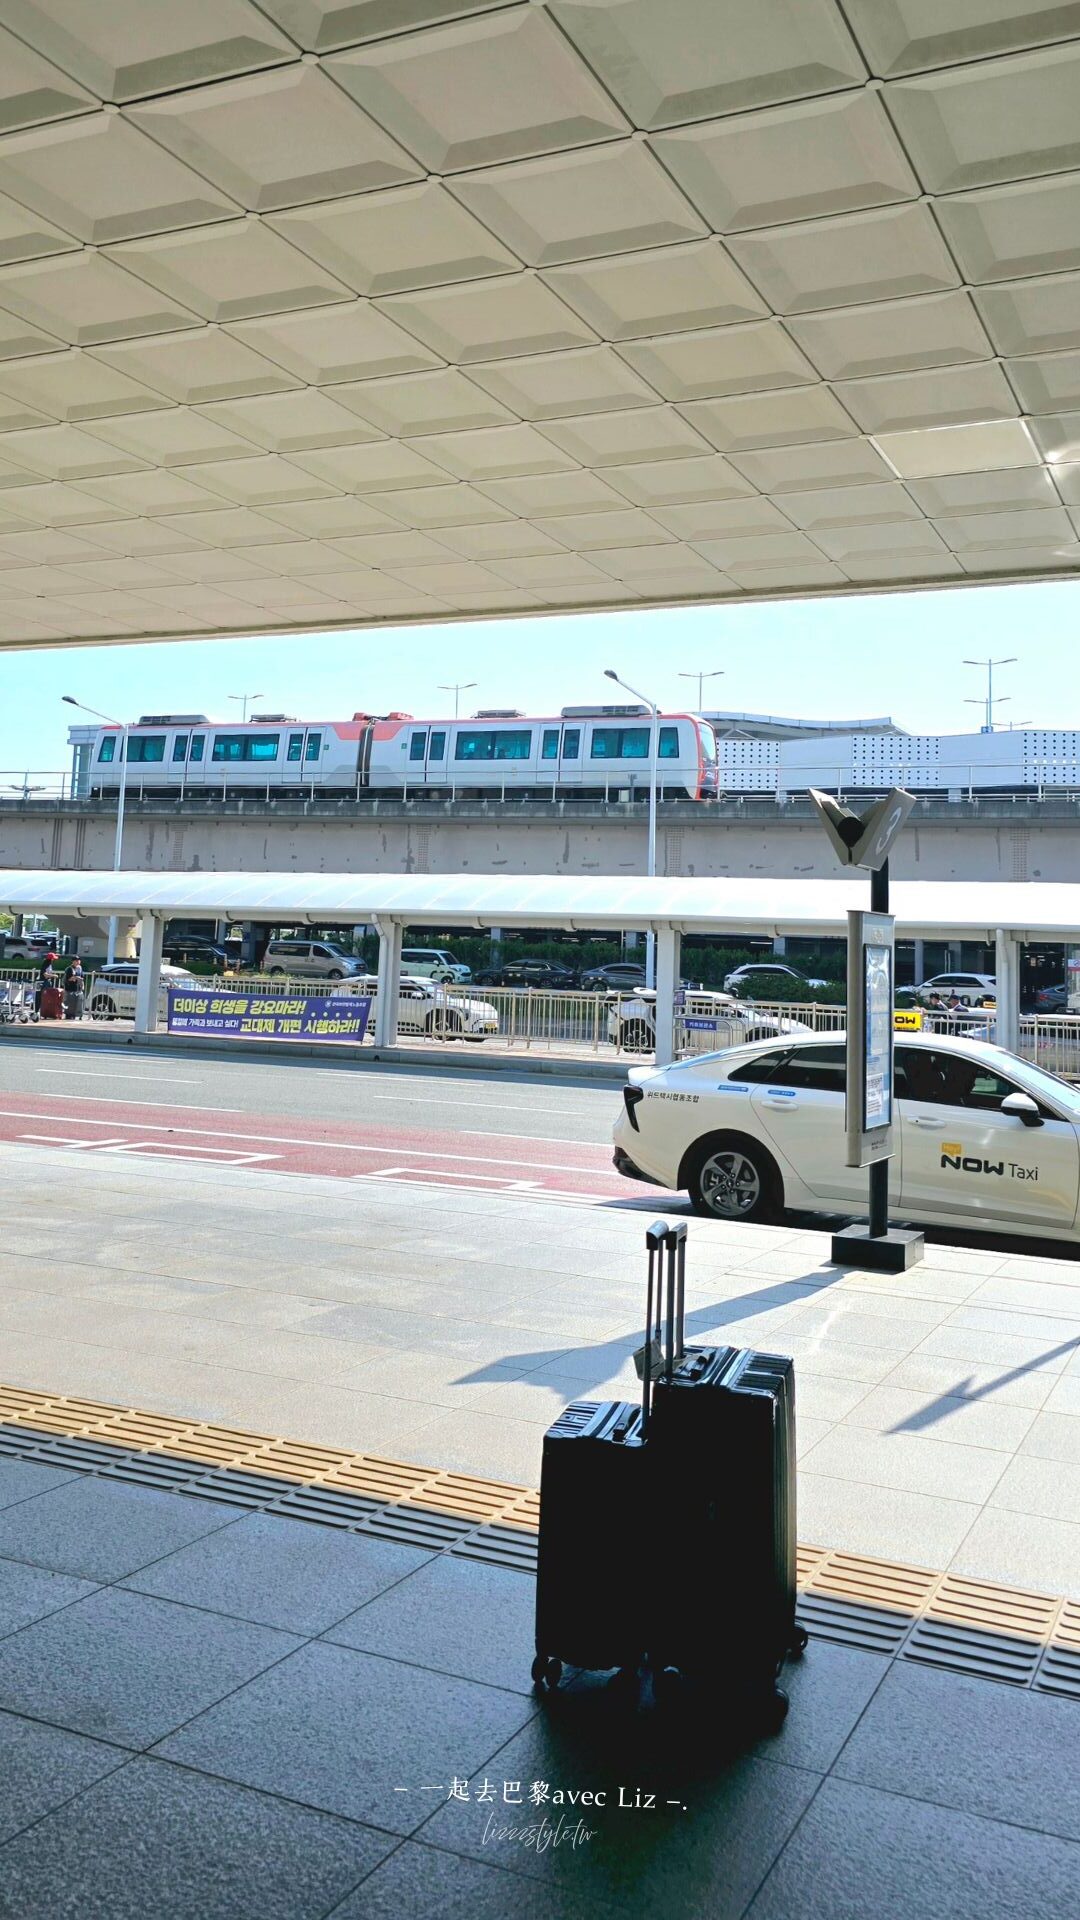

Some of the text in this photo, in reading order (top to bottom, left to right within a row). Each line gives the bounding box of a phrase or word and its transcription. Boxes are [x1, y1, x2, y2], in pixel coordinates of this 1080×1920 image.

[875, 806, 902, 855] 3
[173, 998, 307, 1016] 더이상 희생을 강요마라!
[240, 1018, 275, 1033] 교대제
[277, 1019, 302, 1033] 개편
[304, 1019, 360, 1034] 시행하라!!
[895, 1016, 916, 1025] OW
[941, 1154, 1039, 1181] NOW Taxi
